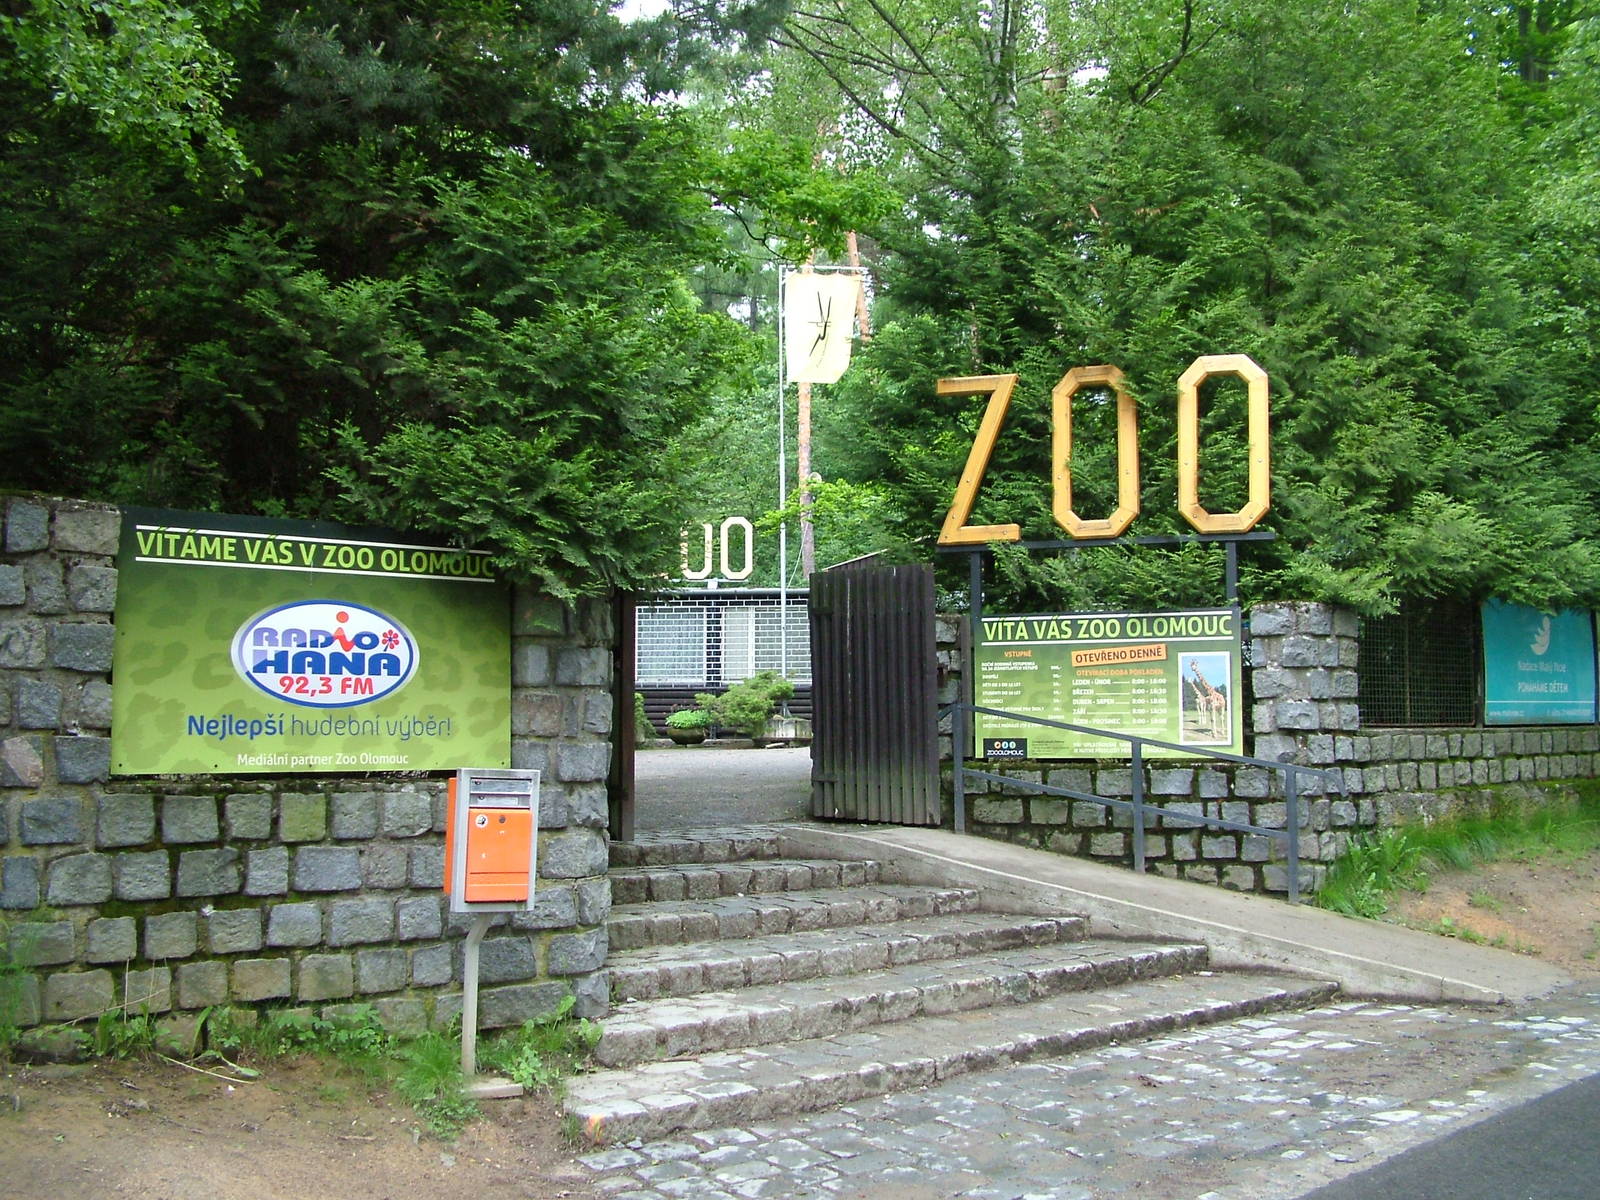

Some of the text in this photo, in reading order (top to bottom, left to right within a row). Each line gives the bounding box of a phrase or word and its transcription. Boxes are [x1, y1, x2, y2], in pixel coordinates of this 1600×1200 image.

[937, 354, 1270, 546] ZOO
[136, 526, 495, 577] VÍTÁME VÁS V ZOO OLOMOUC
[1033, 615, 1072, 640] VÁS
[1077, 619, 1121, 639] ZOO
[1126, 615, 1233, 637] OLOMOUC
[1075, 645, 1162, 663] OTEVŘENO DENNĚ
[279, 676, 374, 697] 92,3 FM
[188, 713, 451, 741] Nejlepší hudební výběr!
[237, 752, 409, 768] Mediální partner Zoo Olomouc
